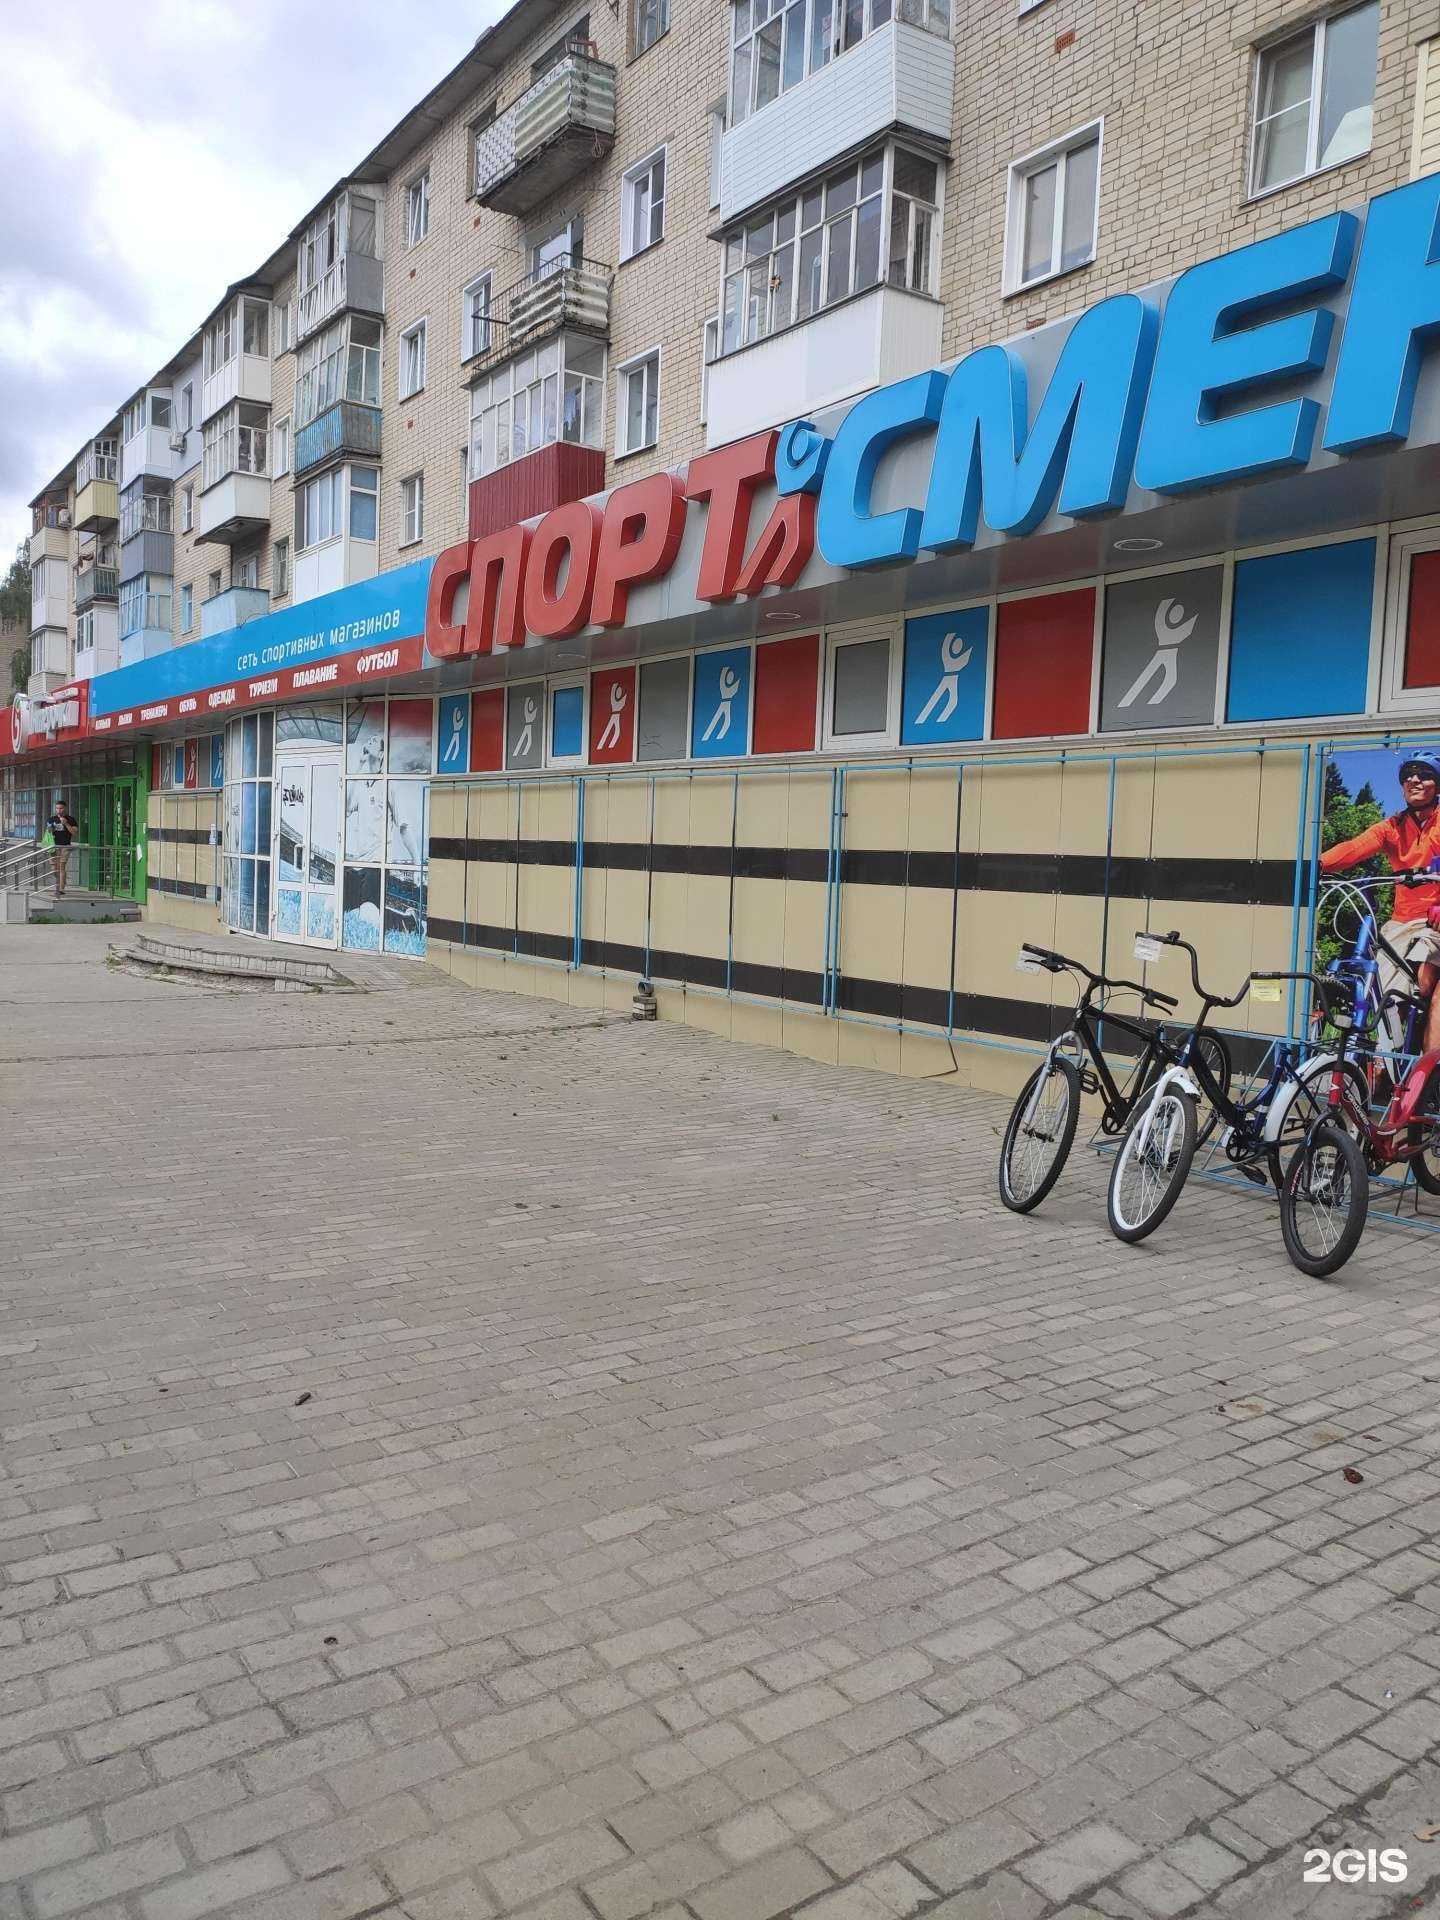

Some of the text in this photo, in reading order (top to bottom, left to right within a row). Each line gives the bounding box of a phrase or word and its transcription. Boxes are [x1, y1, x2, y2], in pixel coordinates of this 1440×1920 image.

[237, 608, 401, 671] сеть спортивных магазинов
[208, 687, 236, 707] ОДЕЖДА
[248, 677, 278, 698] ТУРИЗМ
[292, 663, 338, 689] ПЛАВАНИЕ
[356, 648, 399, 675] ФУТБОЛ
